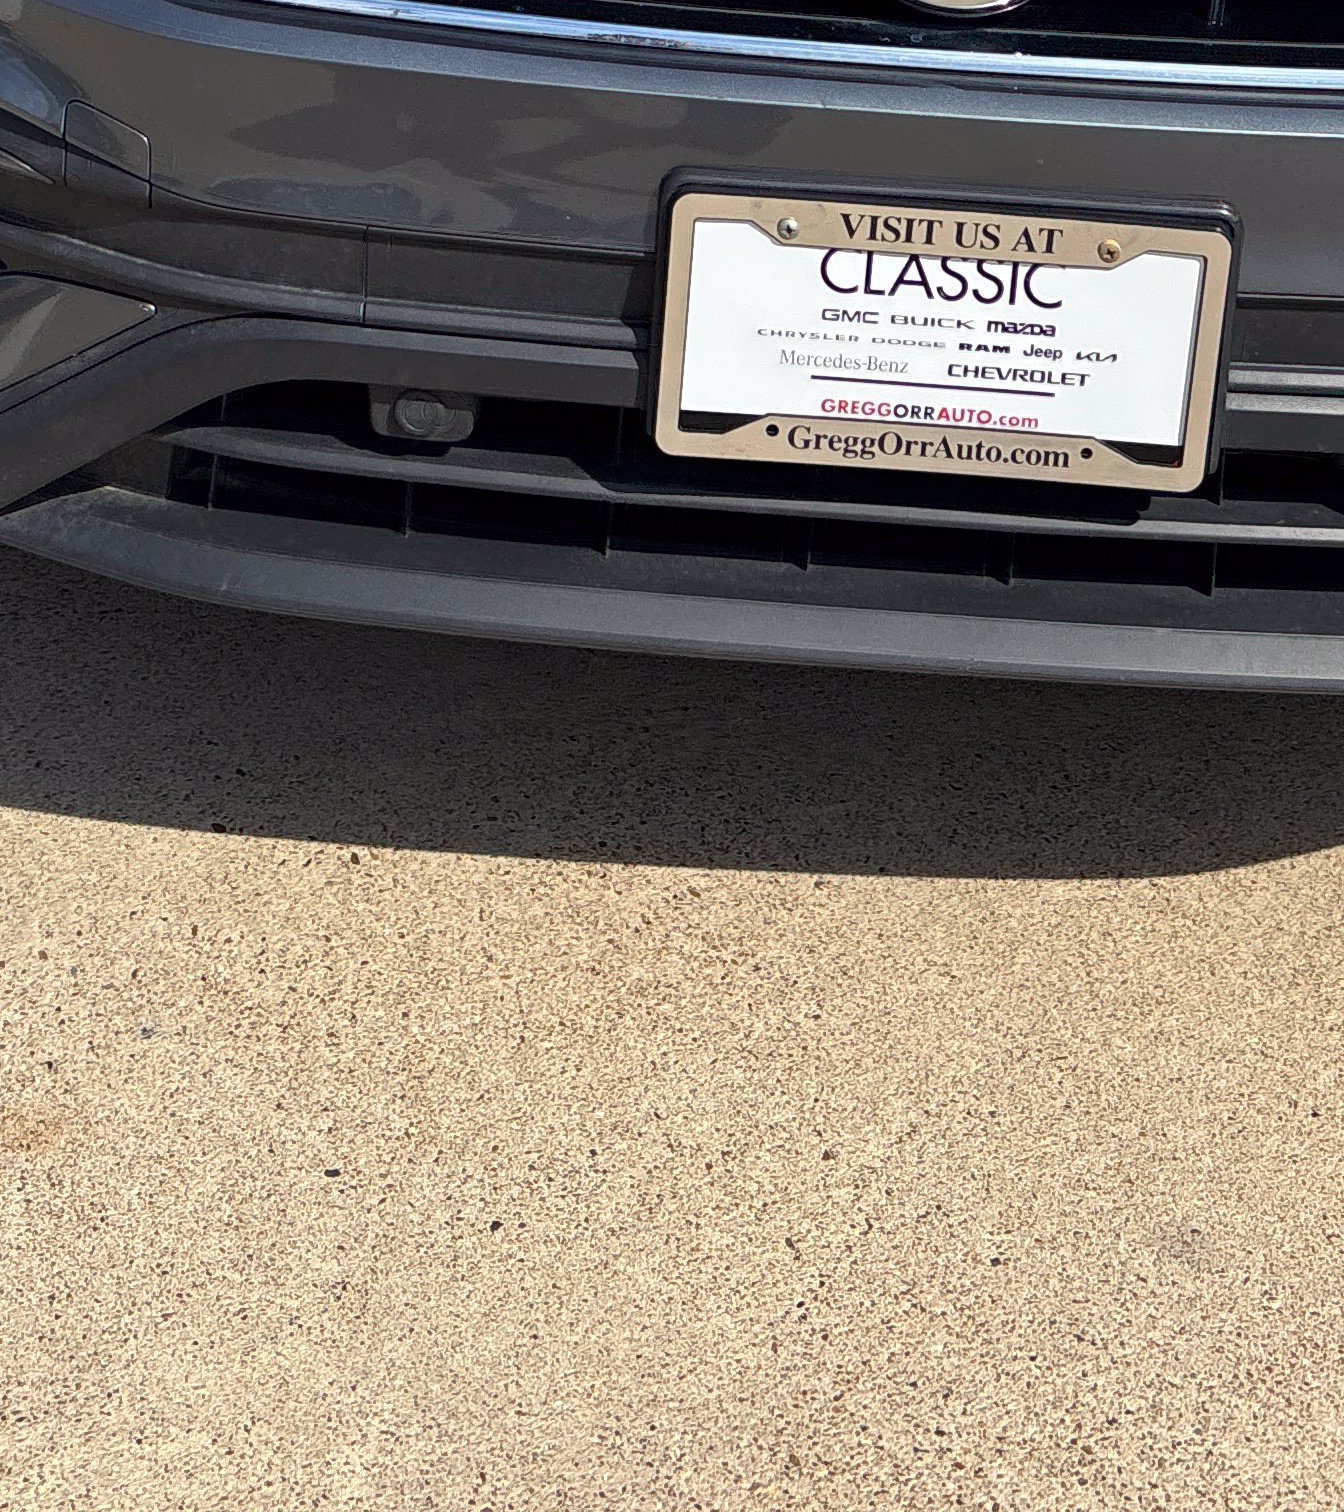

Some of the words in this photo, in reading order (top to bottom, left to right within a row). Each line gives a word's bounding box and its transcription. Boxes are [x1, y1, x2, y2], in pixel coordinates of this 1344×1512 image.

[840, 212, 944, 246] VISIT
[954, 220, 1001, 250] US
[1011, 226, 1064, 255] AT
[820, 247, 1063, 309] CLASSIC
[821, 308, 880, 325] GMC
[890, 314, 976, 331] BUICK
[757, 328, 860, 343] CHRYSLER
[871, 336, 947, 349] DODGE
[958, 342, 1011, 354] RAM
[1022, 343, 1064, 362] Jeep
[779, 349, 909, 374] Mercedes-Benz
[947, 363, 1091, 387] CHEVROLET
[820, 398, 1039, 429] GREGGORRAUTO.com
[787, 424, 1070, 469] GreggOrrAuto.com
